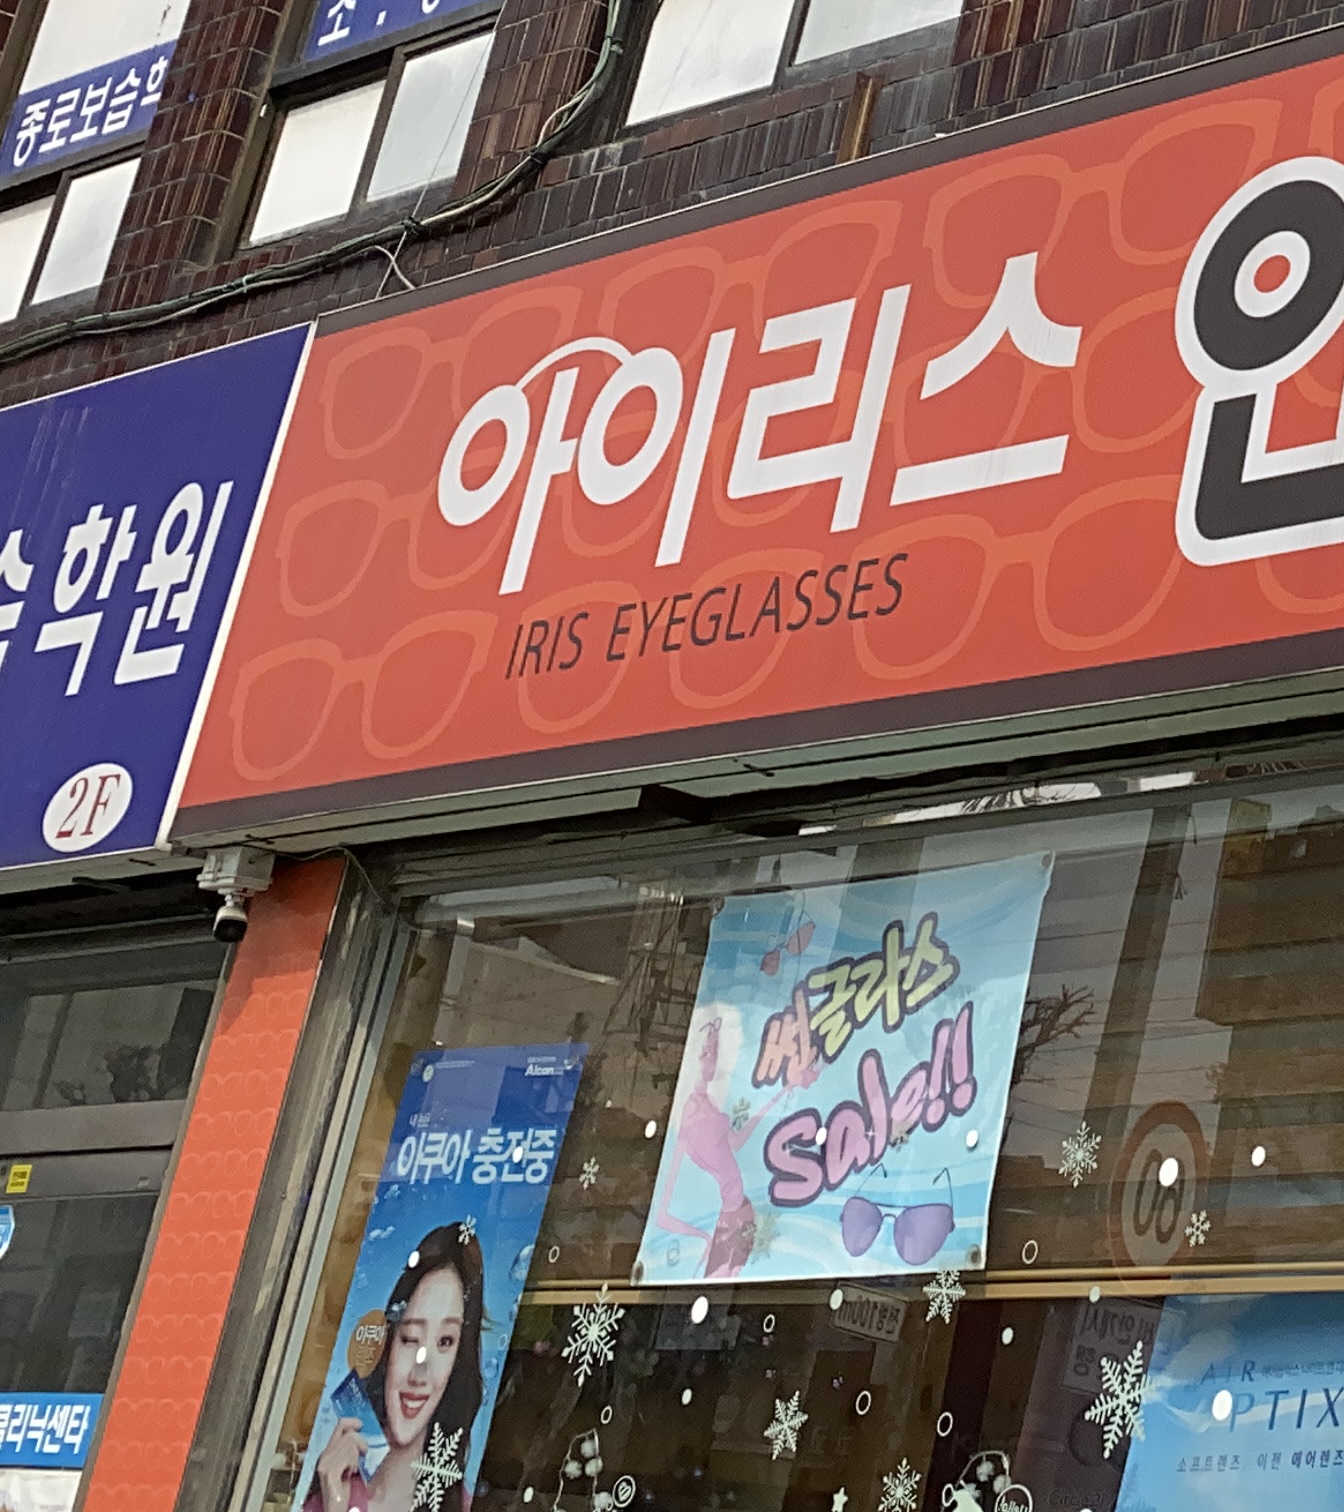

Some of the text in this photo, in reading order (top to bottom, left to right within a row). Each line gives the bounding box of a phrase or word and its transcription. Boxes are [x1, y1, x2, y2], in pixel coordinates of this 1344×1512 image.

[436, 251, 1083, 596] 아이리스
[504, 552, 910, 681] IRIS EYEGLASSES
[55, 773, 121, 840] 2F
[763, 1000, 979, 1207] Sale!!
